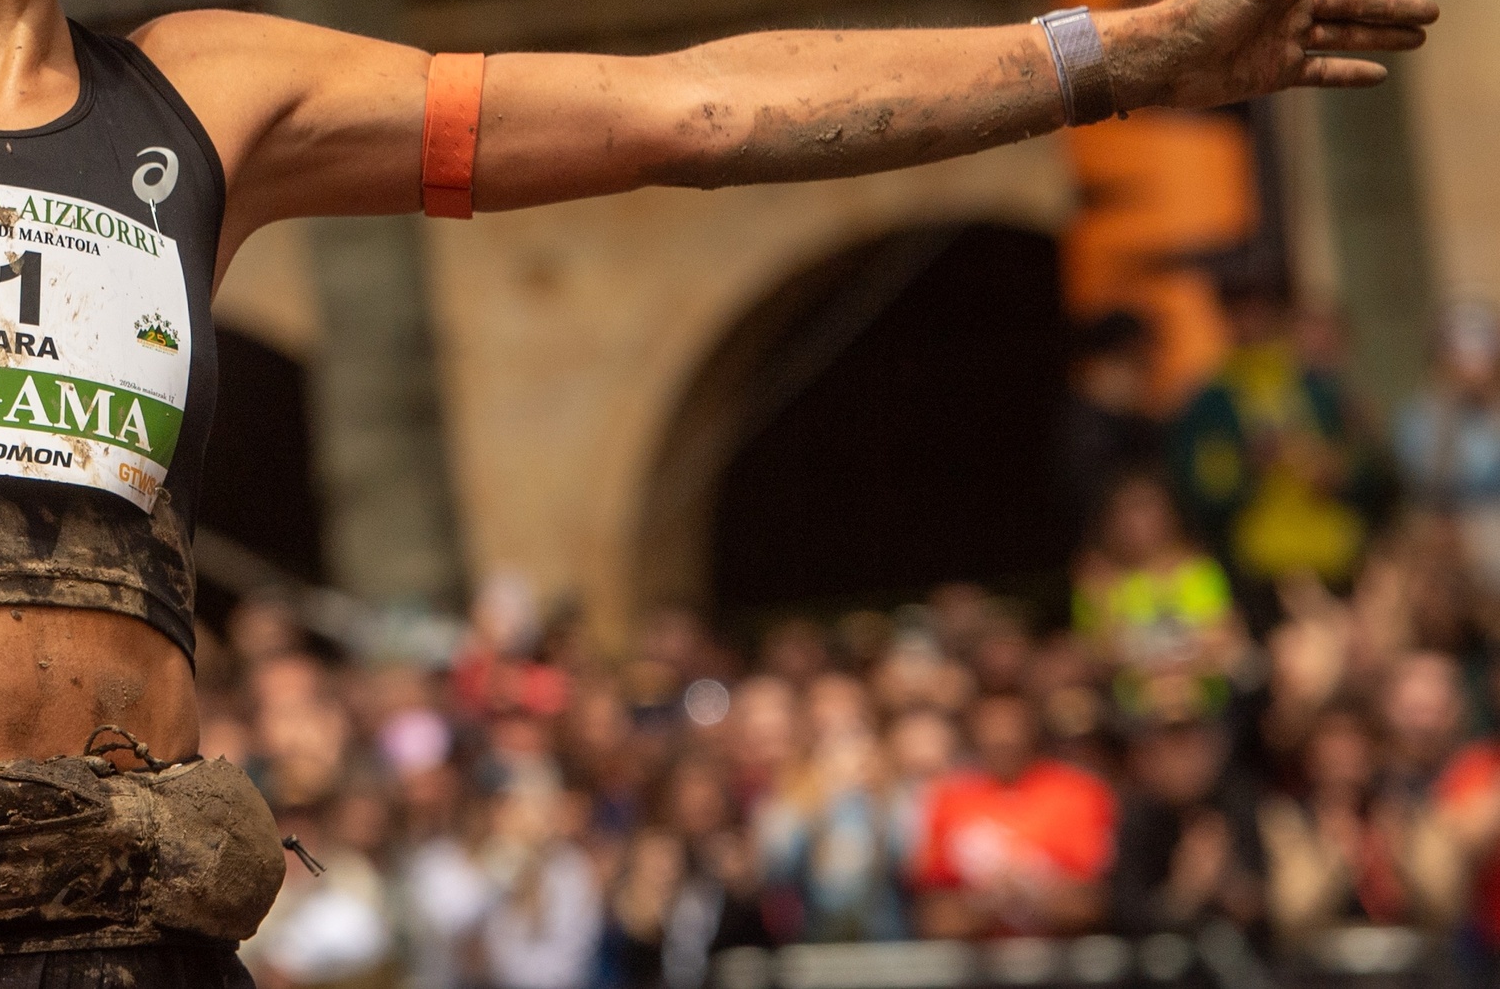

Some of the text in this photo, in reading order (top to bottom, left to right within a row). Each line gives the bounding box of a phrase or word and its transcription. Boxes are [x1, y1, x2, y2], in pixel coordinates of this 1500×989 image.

[19, 227, 101, 257] MARATOIA
[0, 250, 42, 326] 1
[146, 331, 167, 347] 25
